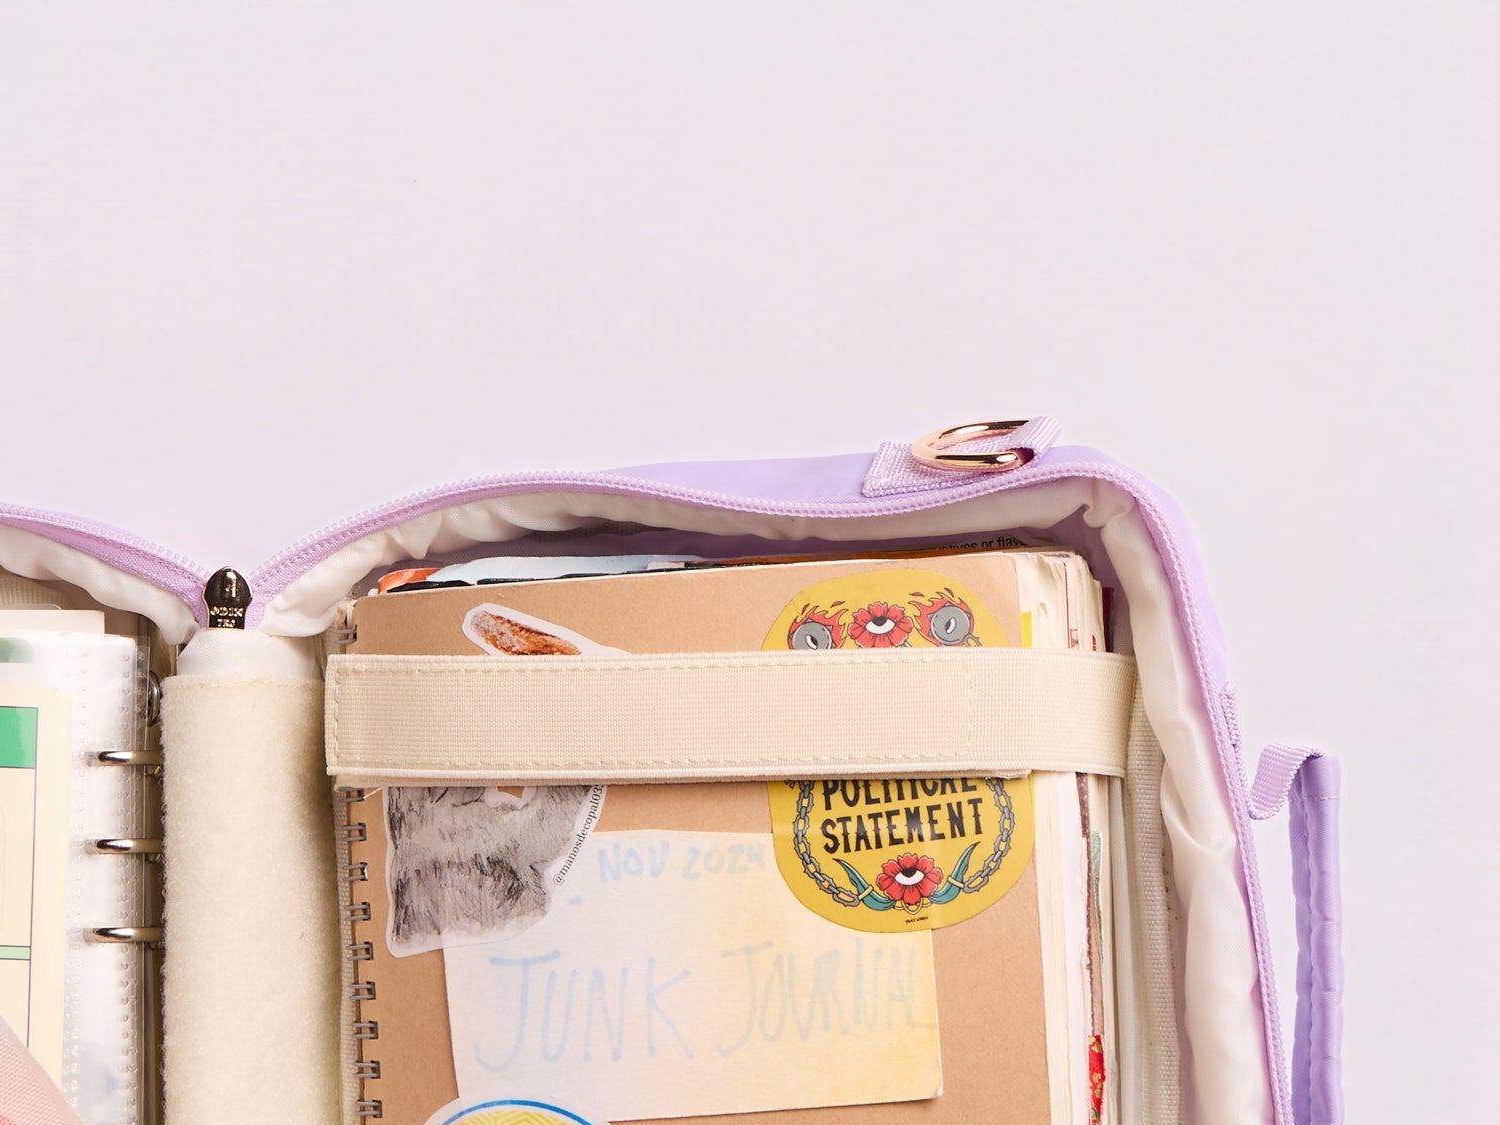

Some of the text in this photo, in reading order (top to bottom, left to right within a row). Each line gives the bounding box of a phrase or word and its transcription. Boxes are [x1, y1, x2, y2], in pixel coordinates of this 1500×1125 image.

[820, 797, 983, 854] STATEMENT
[597, 840, 671, 883] NOV
[473, 937, 938, 1072] JUNK JOURNAL
